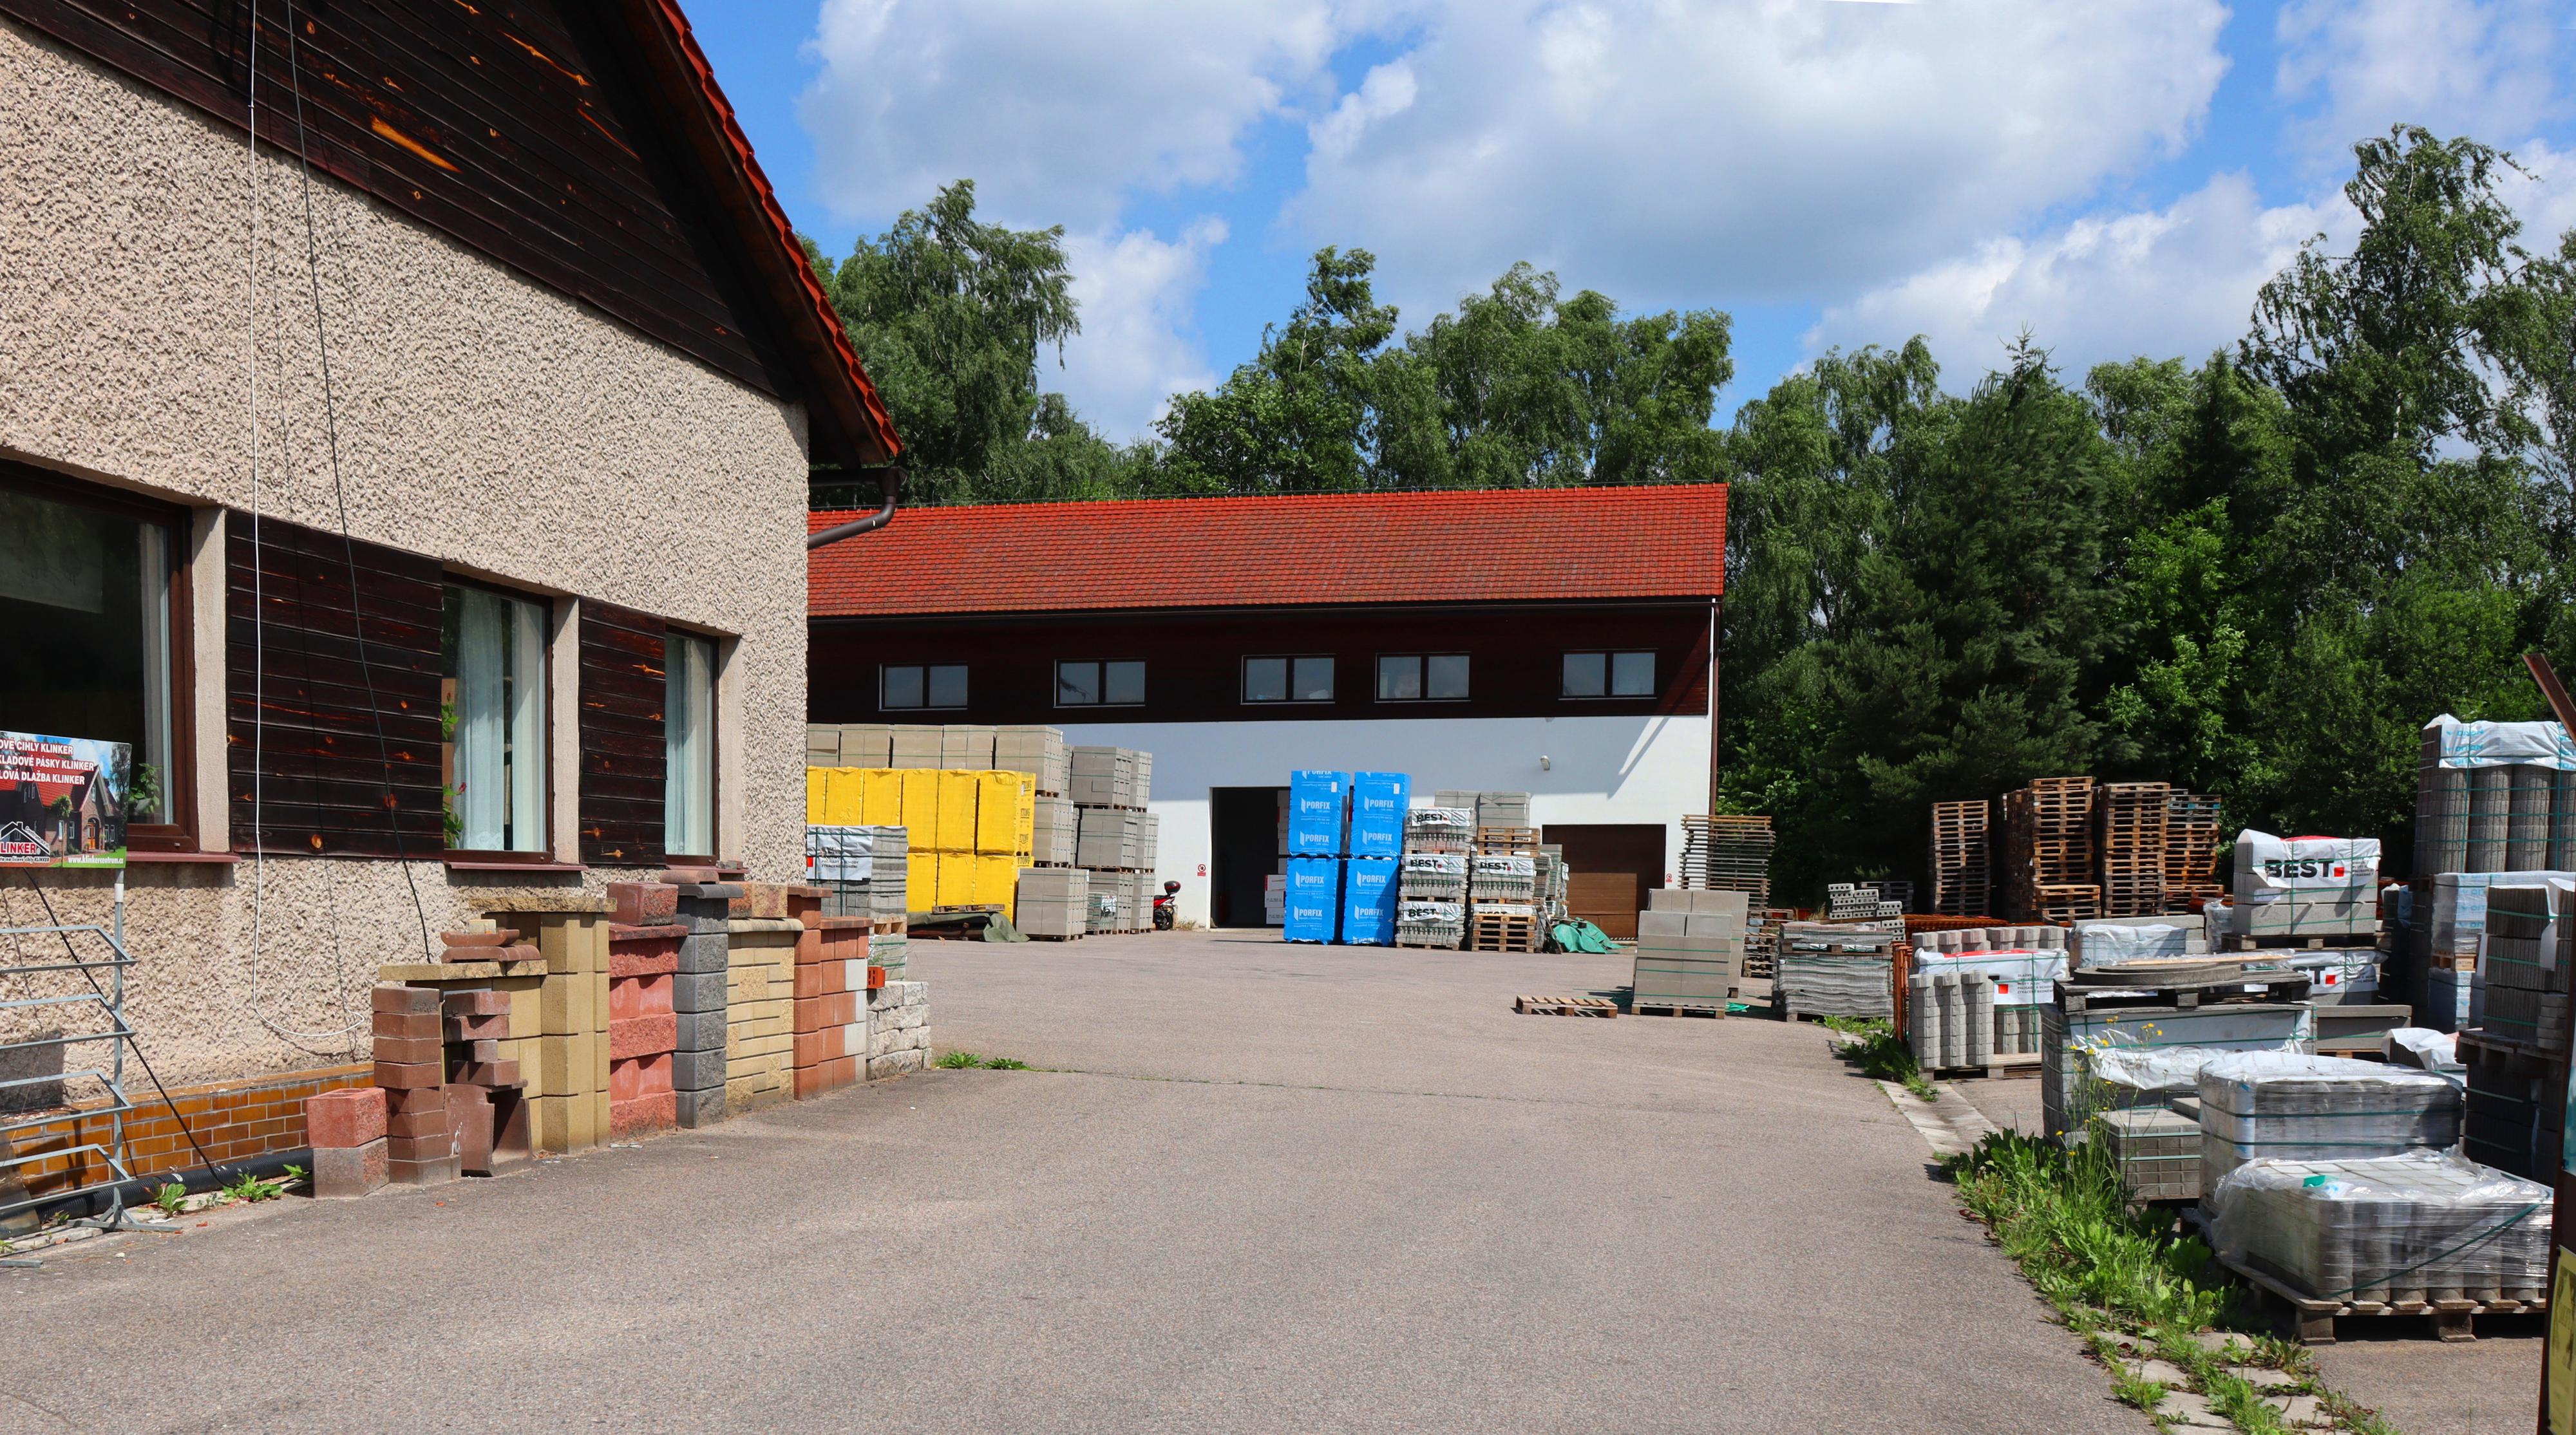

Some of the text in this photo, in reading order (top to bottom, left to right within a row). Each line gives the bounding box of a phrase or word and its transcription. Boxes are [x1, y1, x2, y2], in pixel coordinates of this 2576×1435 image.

[17, 741, 39, 752] CIHLY
[41, 744, 73, 755] KLINKER
[35, 756, 61, 769] PÁSKY
[62, 760, 95, 771] KLINKER
[21, 770, 51, 782] DLAŽBA
[52, 774, 85, 785] KLINKER
[1306, 801, 1331, 809] PORFIX
[1370, 799, 1394, 808] PORFIX
[1305, 834, 1329, 843] PORFIX
[1368, 832, 1392, 841] PORFIX
[2265, 858, 2334, 877] BEST
[1300, 876, 1325, 884] PORFIX
[1362, 874, 1386, 883] PORFIX
[1299, 908, 1323, 917] PORFIX
[1359, 908, 1384, 916] PORFIX
[1408, 908, 1436, 917] BEST
